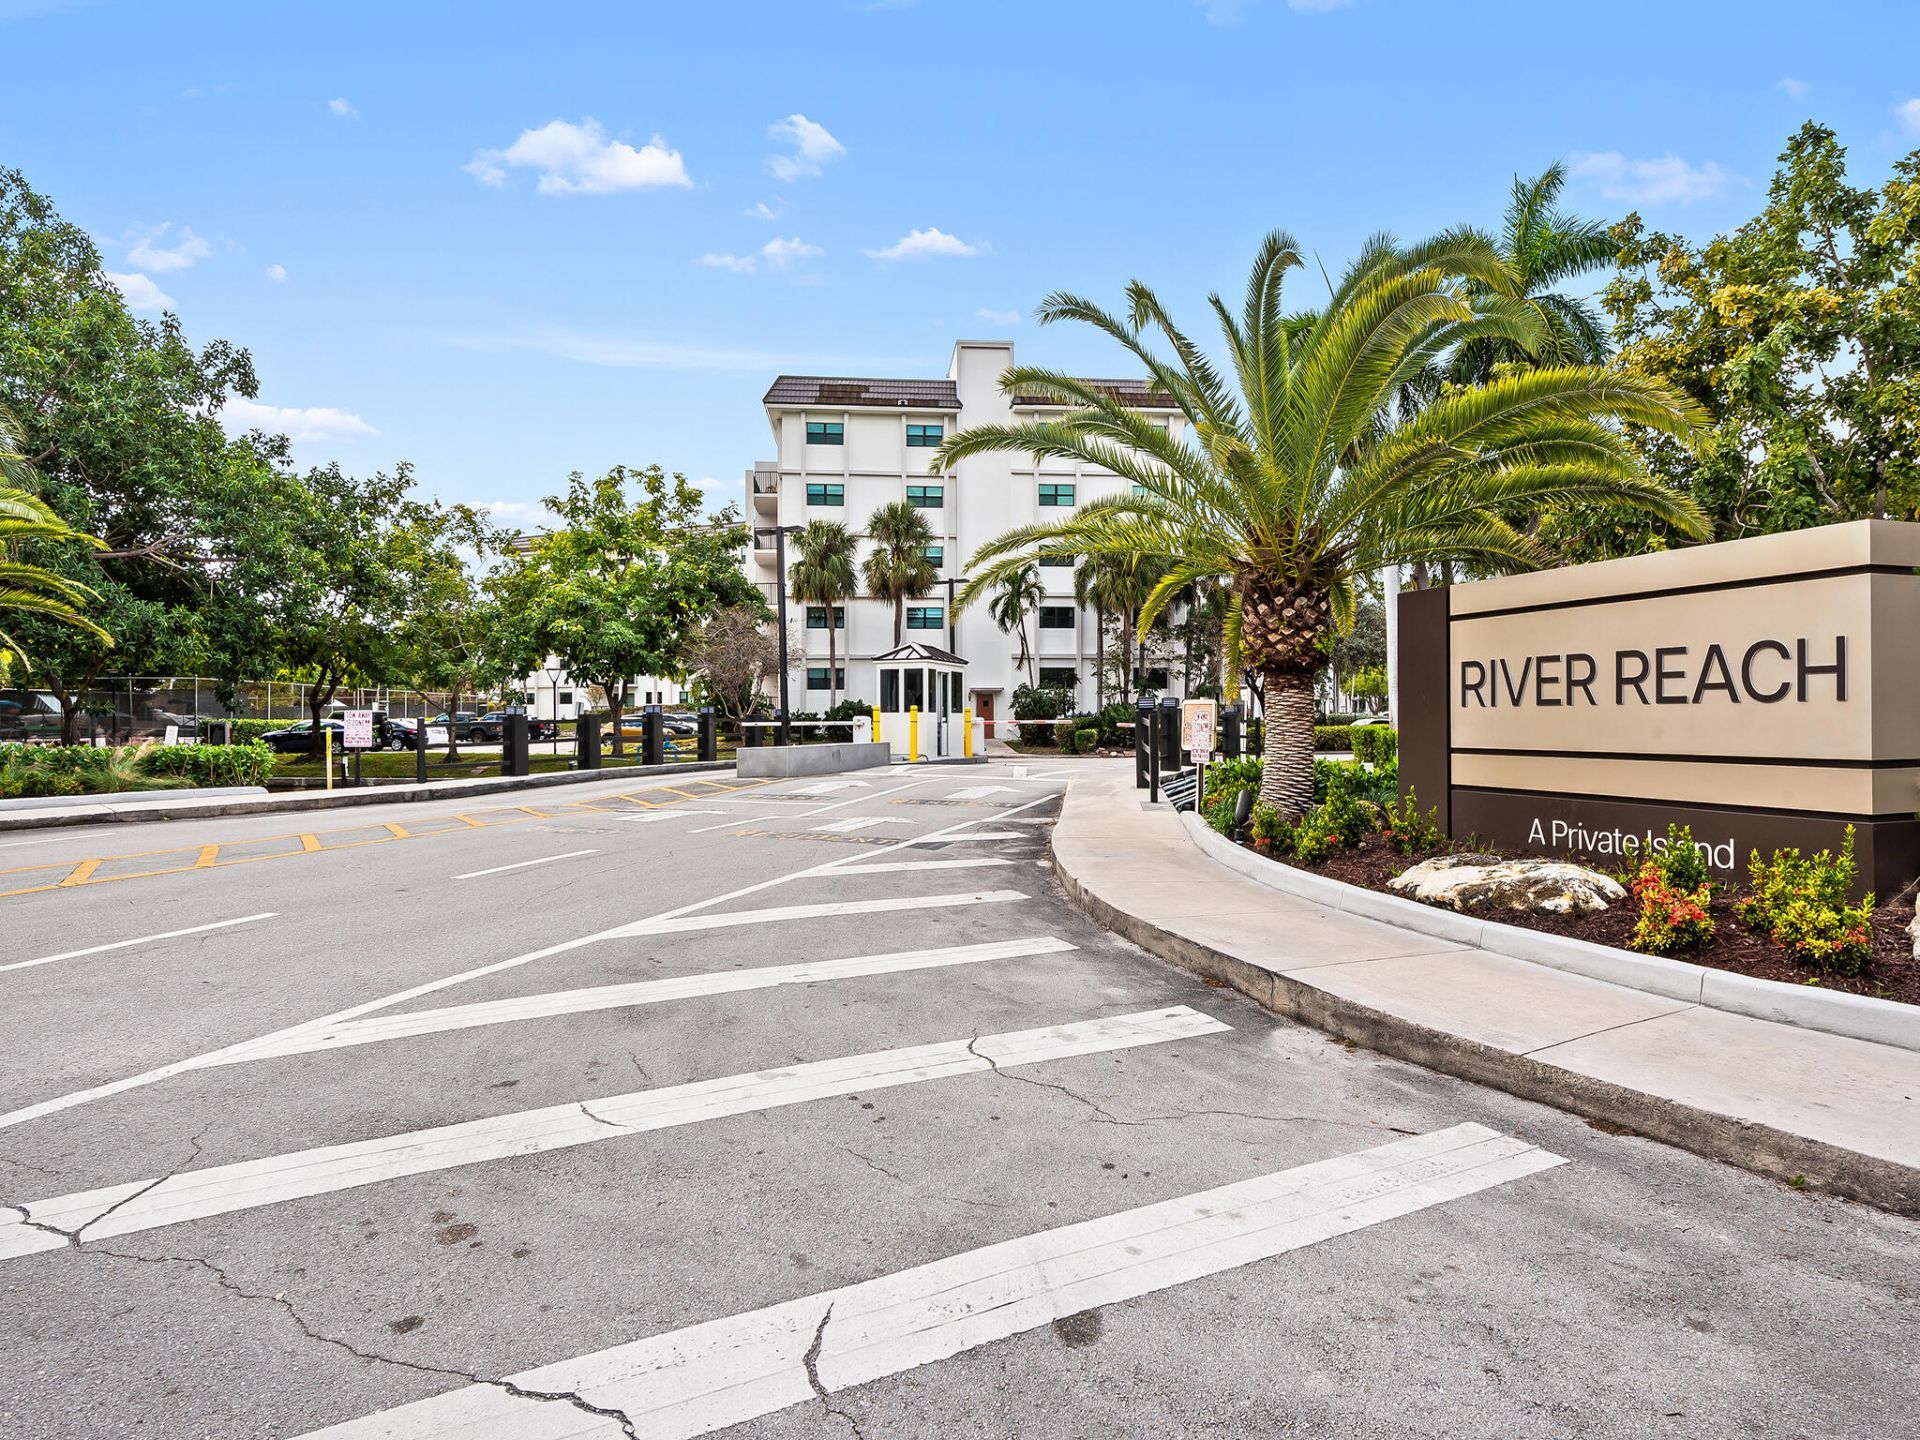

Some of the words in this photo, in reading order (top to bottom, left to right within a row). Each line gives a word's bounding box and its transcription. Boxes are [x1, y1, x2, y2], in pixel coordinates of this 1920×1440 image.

[1461, 652, 1598, 708] RIVER
[1615, 635, 1848, 706] REACH
[1528, 818, 1546, 846] A
[1552, 819, 1640, 857] Private
